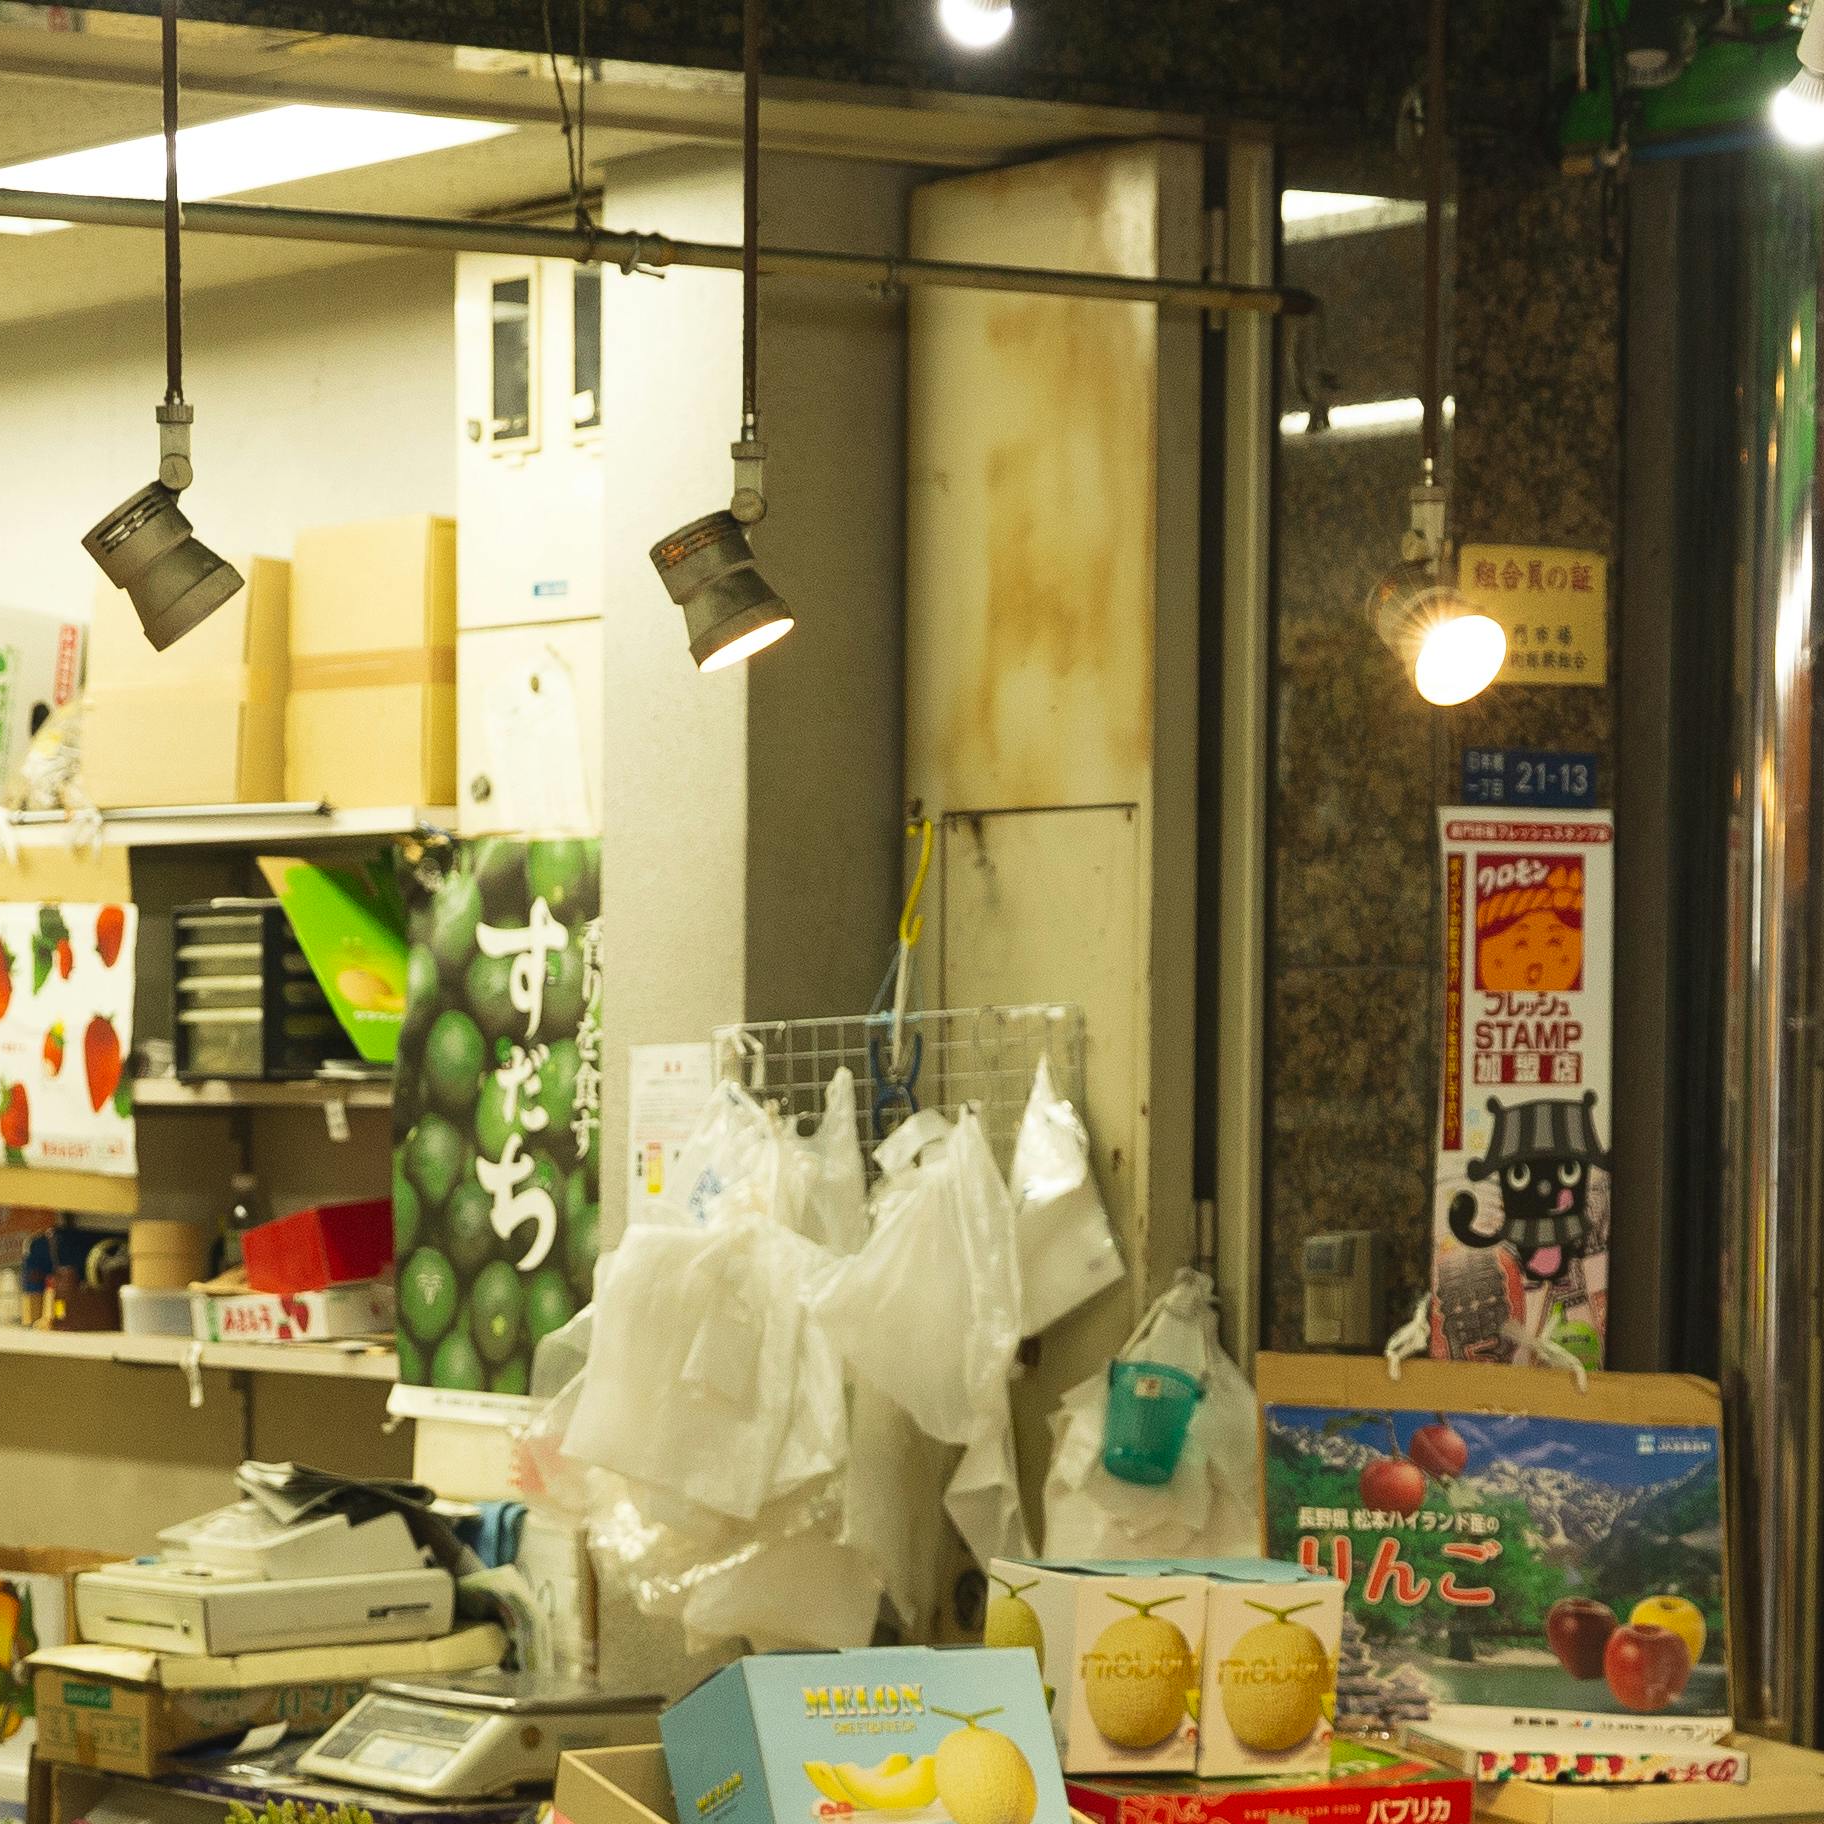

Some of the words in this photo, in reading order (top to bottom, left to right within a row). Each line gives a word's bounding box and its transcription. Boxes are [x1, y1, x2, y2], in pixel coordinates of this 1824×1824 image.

[1515, 761, 1589, 797] 21-13
[1475, 1021, 1582, 1050] STAMP
[476, 895, 569, 1272] すだち
[801, 1682, 927, 1719] MELON
